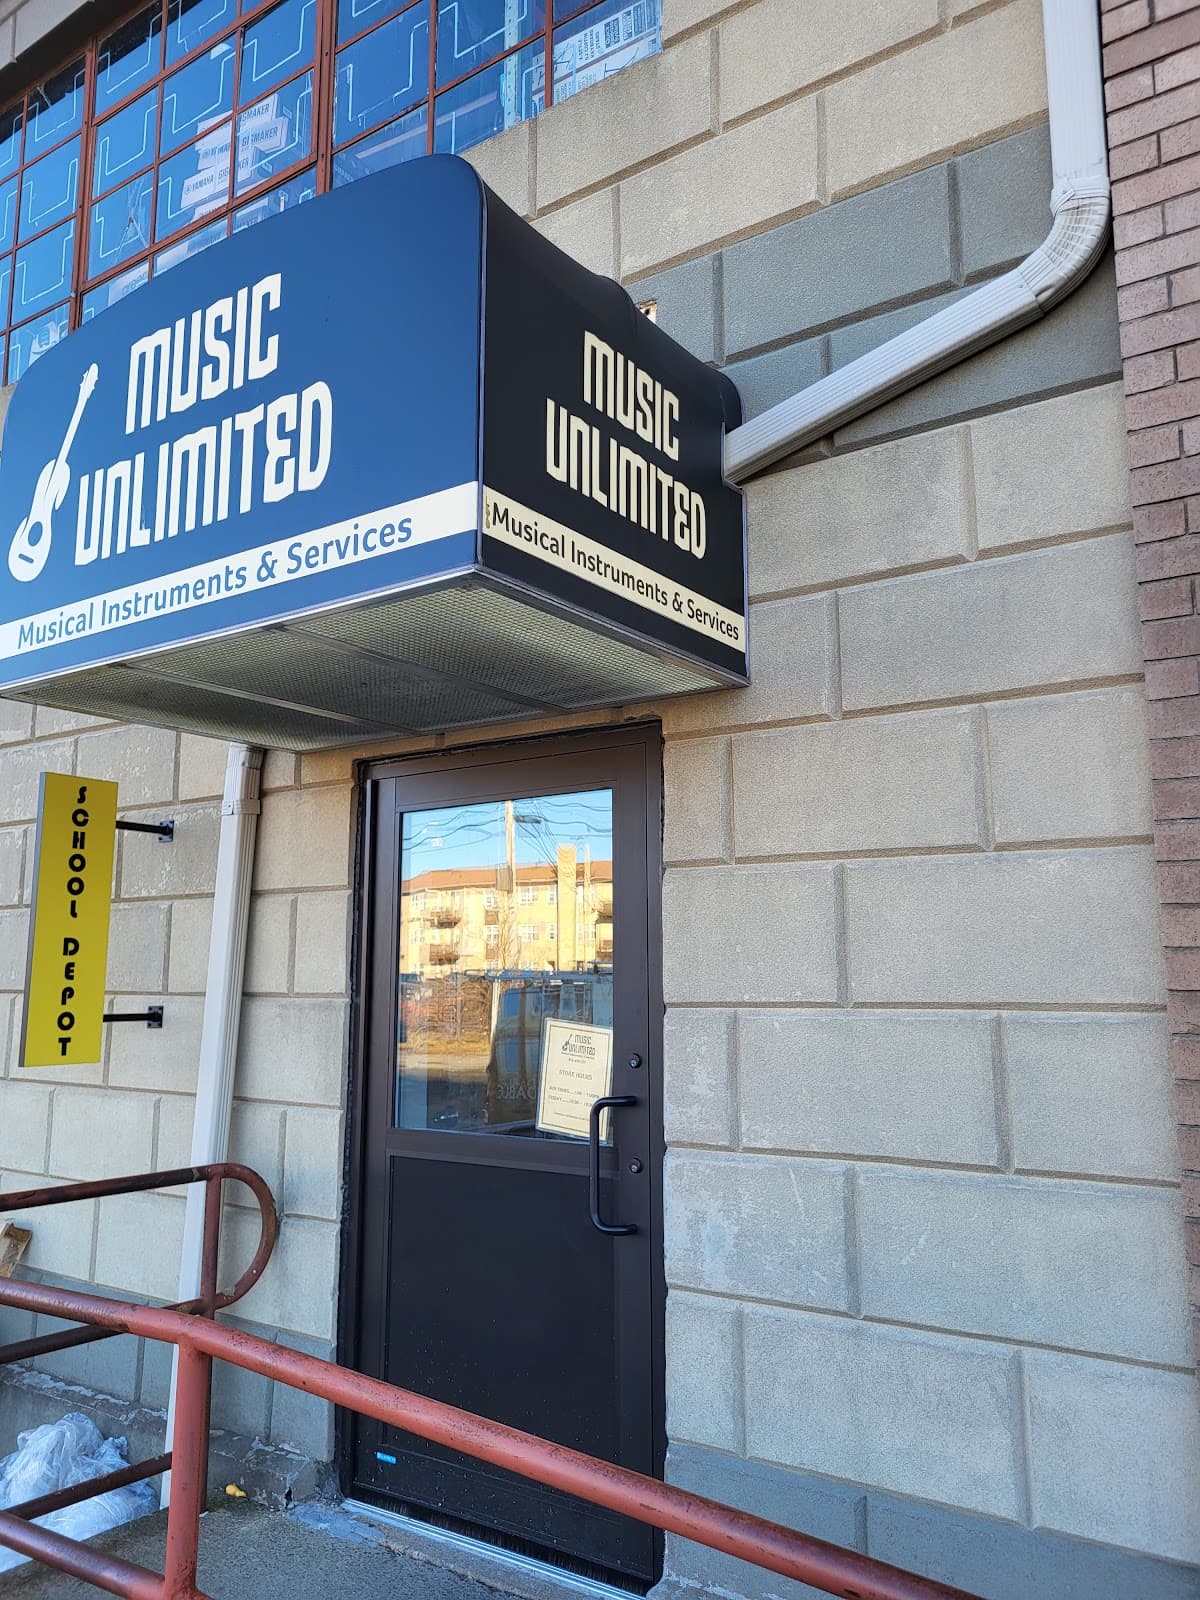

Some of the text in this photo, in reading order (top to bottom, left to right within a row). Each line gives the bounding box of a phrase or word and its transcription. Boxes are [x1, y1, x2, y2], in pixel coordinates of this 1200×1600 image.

[125, 272, 282, 435] MUSIC
[583, 330, 679, 462] MUSIC
[74, 380, 333, 567] UNLIMITED
[546, 397, 707, 560] UNLIMITED
[18, 515, 412, 650] Musical Instruments & Services
[492, 502, 740, 641] Musical Instruments & Services
[57, 786, 89, 1056] SCHOOL DEPOT
[574, 1034, 592, 1045] MUSIC
